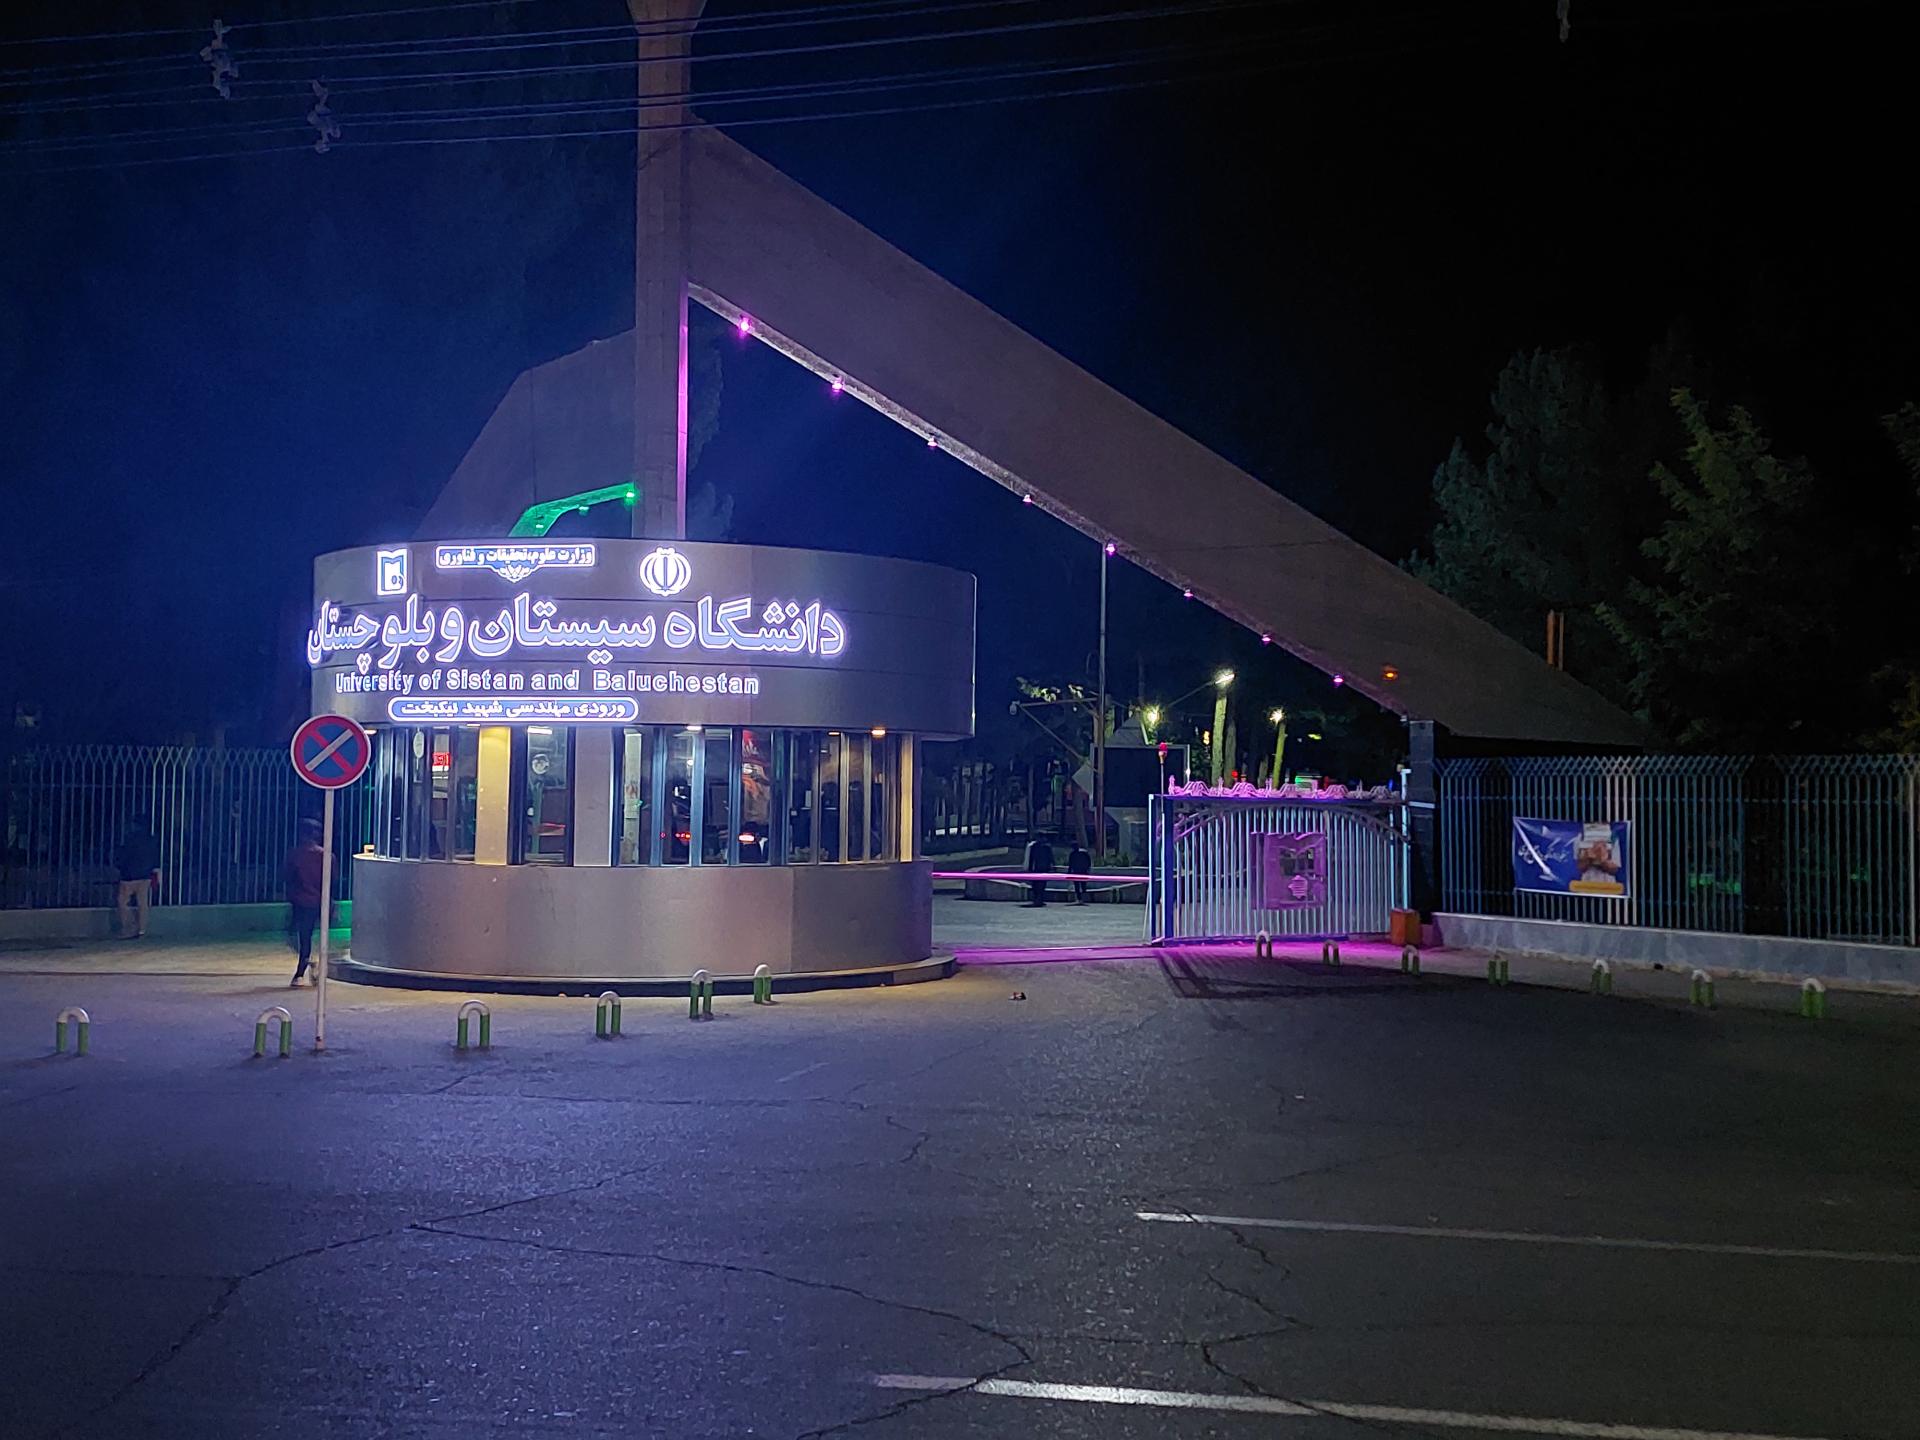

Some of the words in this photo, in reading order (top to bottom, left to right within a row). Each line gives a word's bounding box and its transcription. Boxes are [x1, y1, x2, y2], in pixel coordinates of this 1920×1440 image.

[439, 547, 476, 566] فناوری
[477, 551, 486, 565] و
[557, 547, 593, 565] وزارت
[307, 593, 436, 675] بلوچستان
[435, 606, 465, 663] و
[468, 592, 656, 666] سیستان
[663, 596, 844, 655] دانشگاه
[335, 670, 415, 694] University
[418, 668, 442, 690] of
[446, 668, 524, 691] Sistan
[530, 669, 580, 691] and
[592, 669, 760, 695] Baluchestan
[401, 701, 459, 718] نیکبخت
[461, 700, 503, 718] شهید
[506, 700, 571, 718] مهندسی
[573, 702, 626, 718] ورودی
